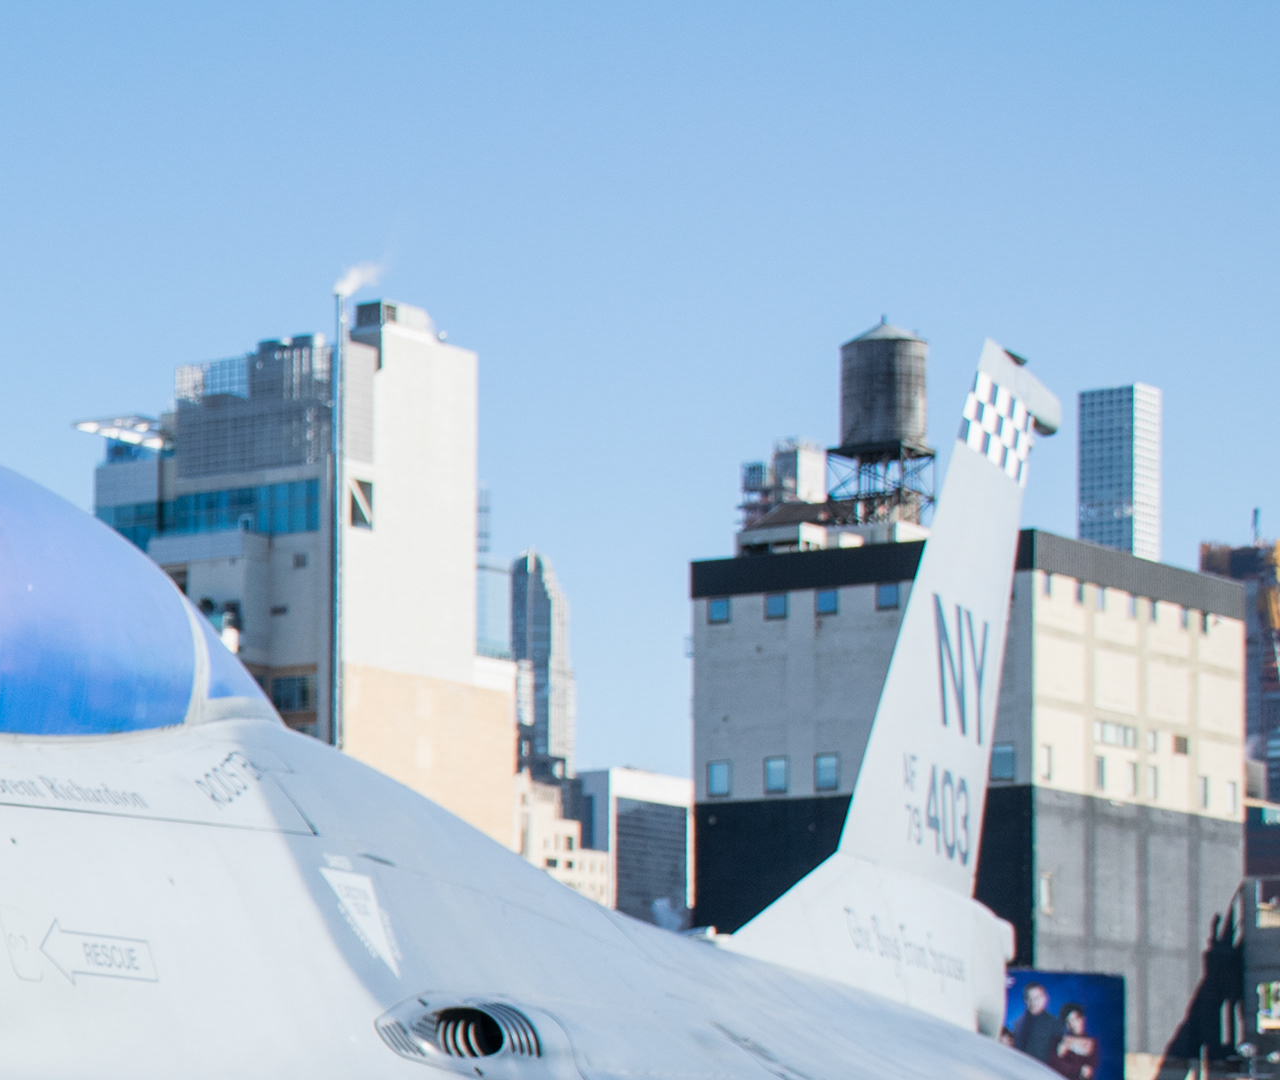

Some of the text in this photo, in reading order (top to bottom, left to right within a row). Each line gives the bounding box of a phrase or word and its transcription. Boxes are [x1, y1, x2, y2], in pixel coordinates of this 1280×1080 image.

[931, 592, 989, 746] NY
[38, 775, 149, 809] Richardson
[904, 803, 923, 846] 79
[925, 764, 969, 867] 403
[82, 942, 140, 970] RESCUE
